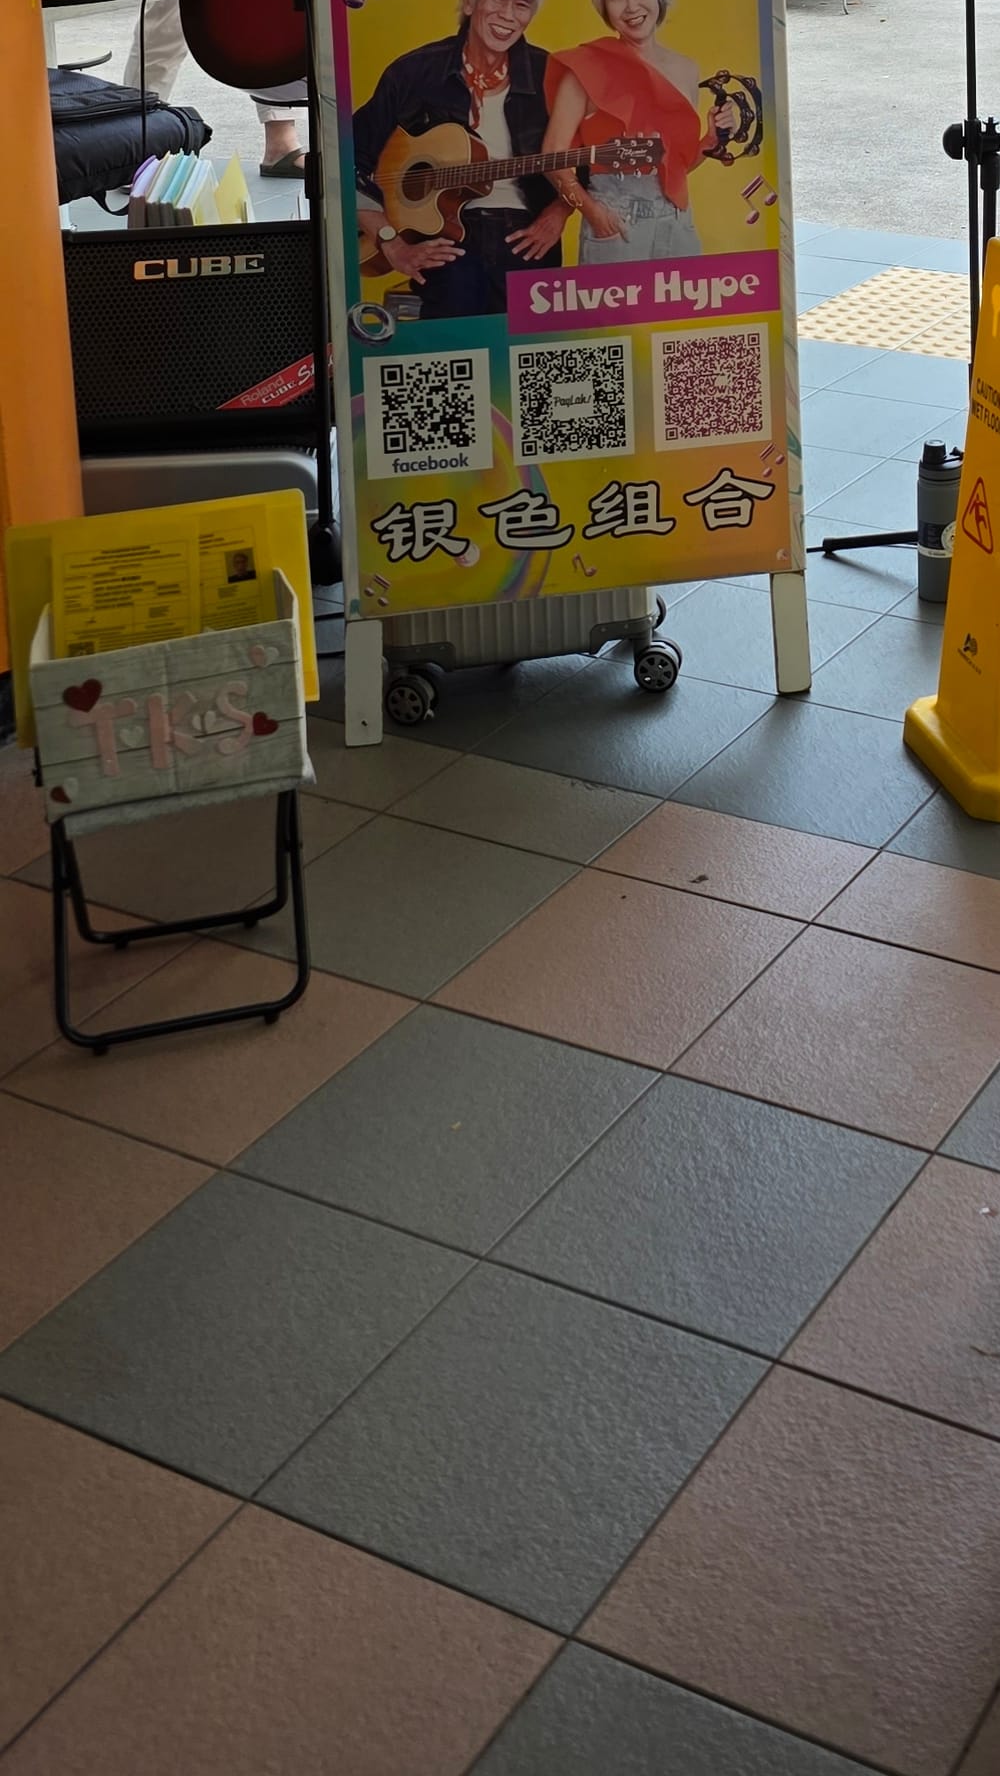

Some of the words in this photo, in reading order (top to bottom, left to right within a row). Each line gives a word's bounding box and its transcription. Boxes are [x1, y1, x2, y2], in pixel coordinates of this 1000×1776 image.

[133, 253, 265, 281] CUBE
[529, 279, 643, 315] Silver
[654, 270, 761, 311] Hype
[240, 374, 285, 406] Roland
[262, 379, 297, 404] CUBE
[971, 398, 984, 422] WET
[392, 452, 469, 473] facebook
[370, 467, 775, 562] 银色组合
[68, 681, 254, 775] TKS
